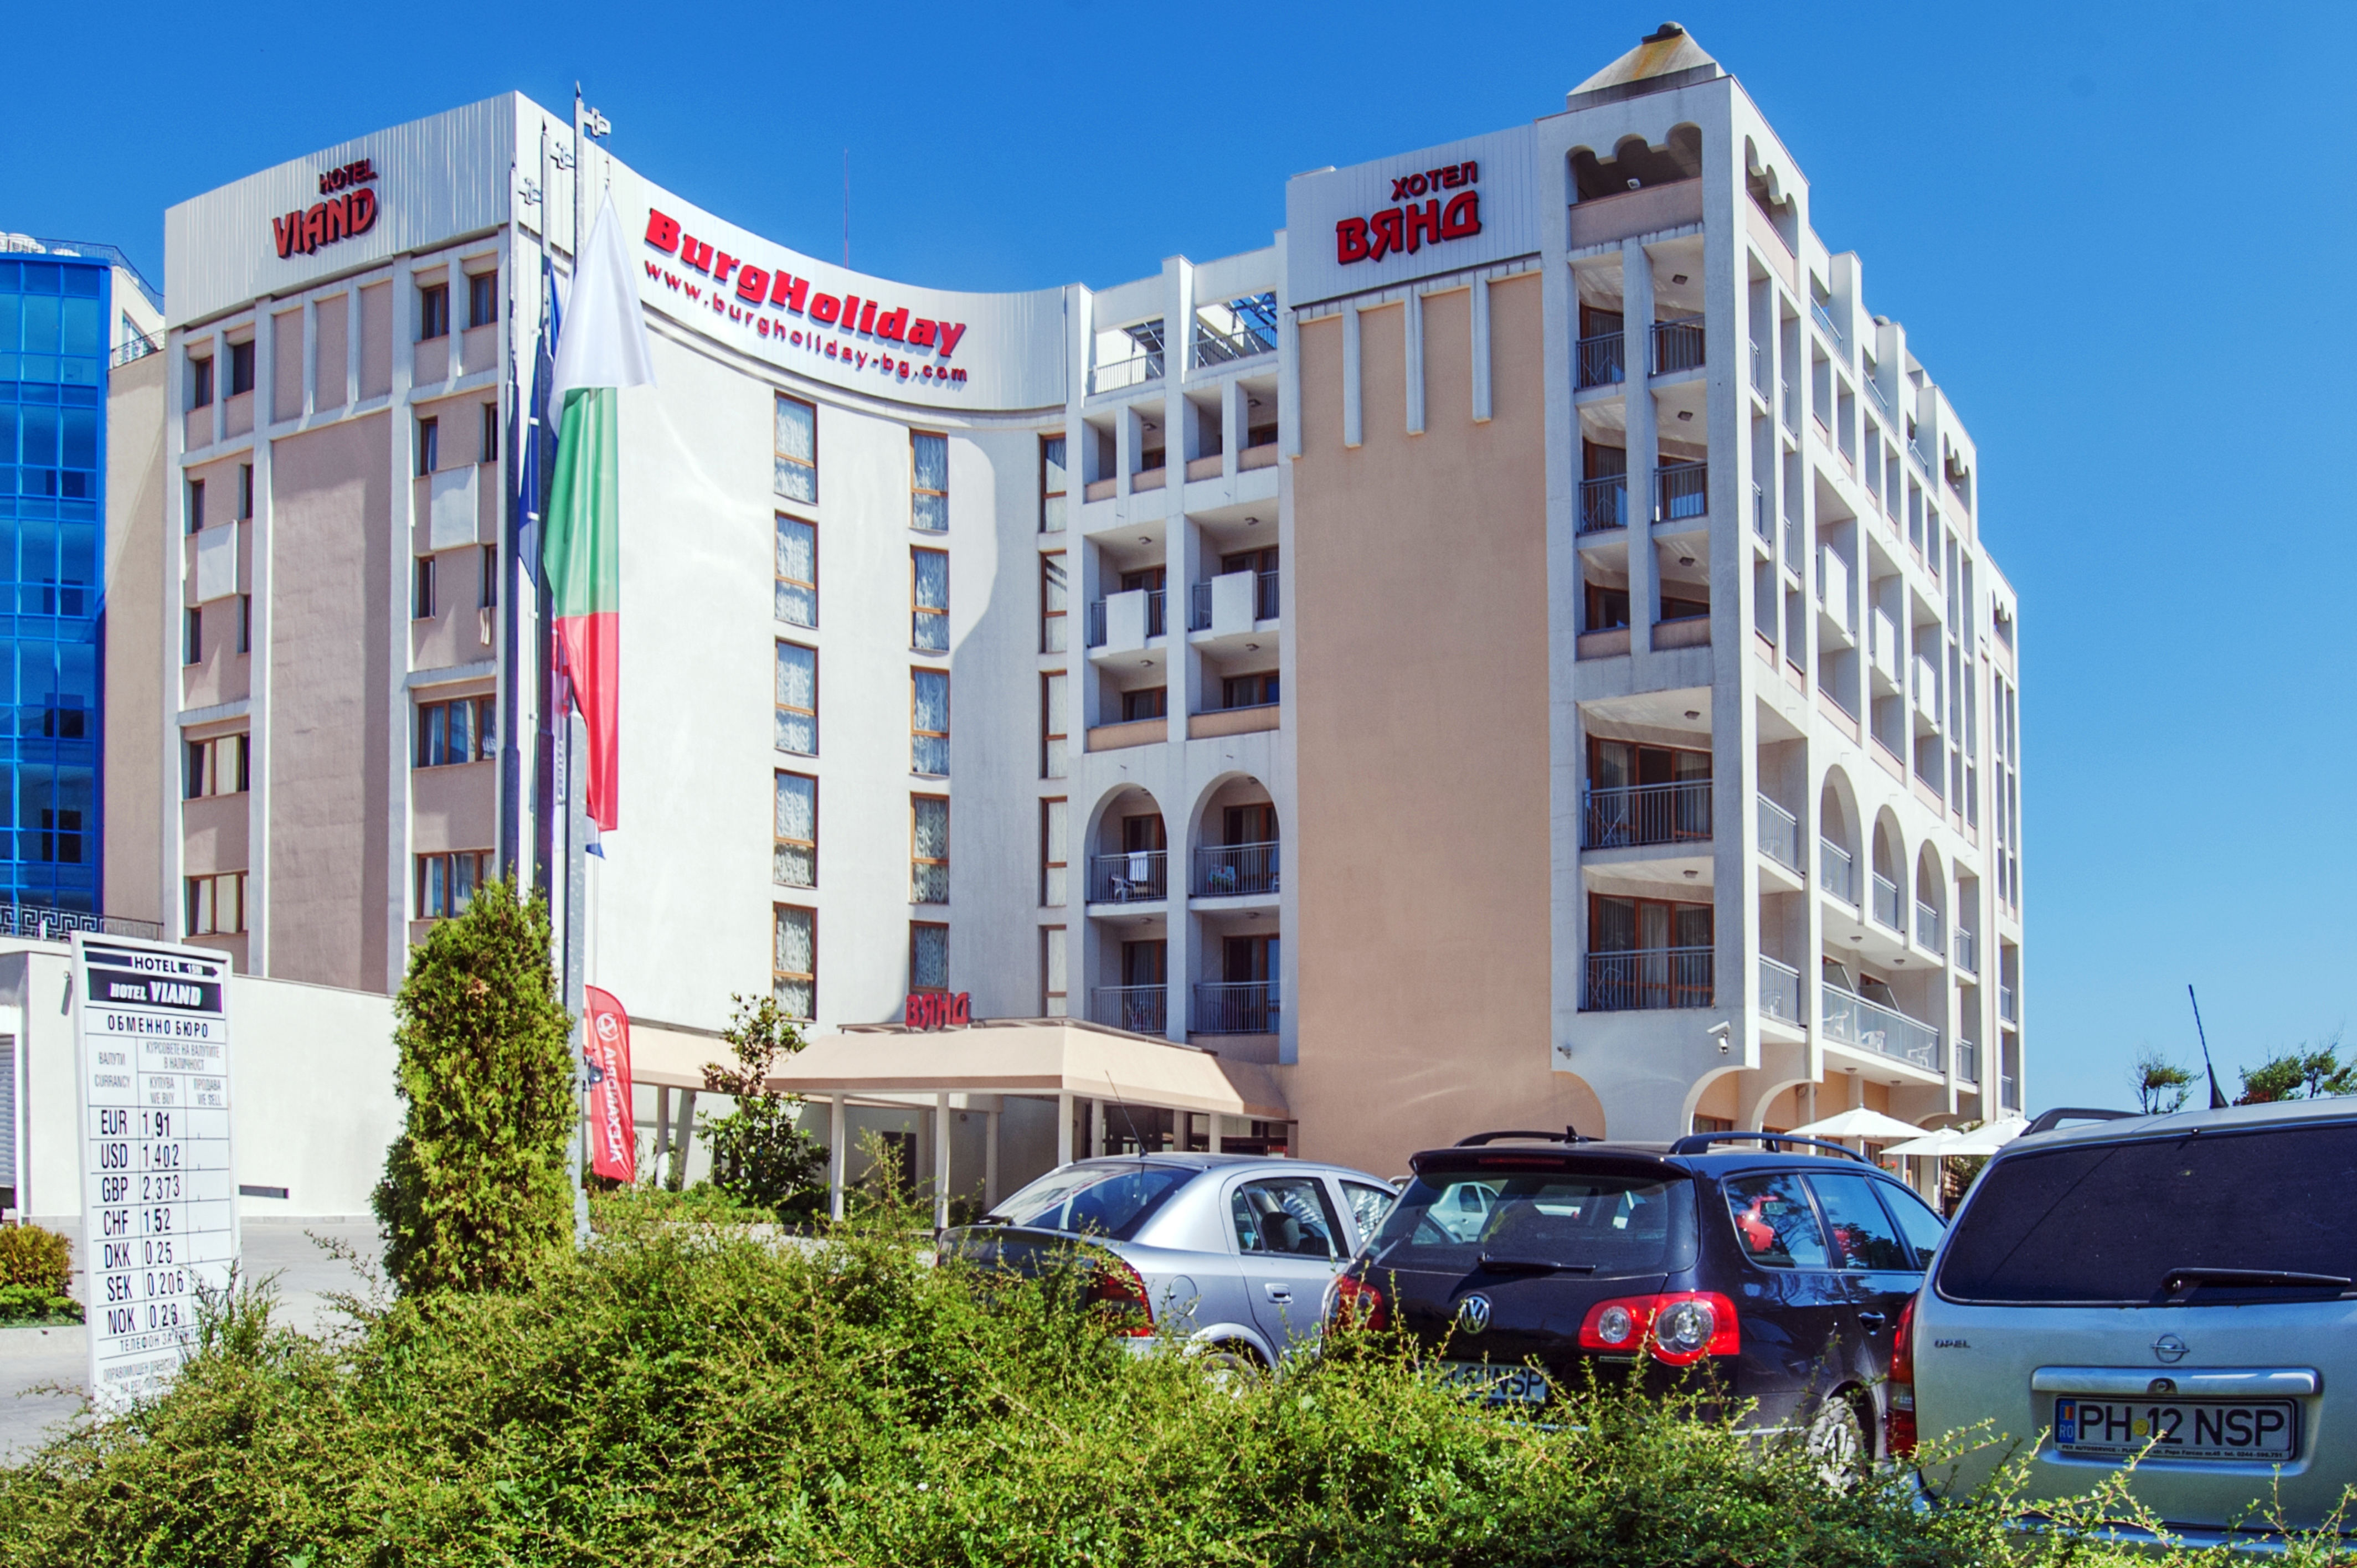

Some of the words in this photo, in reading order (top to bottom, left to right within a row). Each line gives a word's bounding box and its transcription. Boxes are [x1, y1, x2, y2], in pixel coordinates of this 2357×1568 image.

[319, 158, 378, 195] HOTEL
[1391, 161, 1478, 202] ХОТЕЛ
[272, 188, 378, 259] VIAND
[1336, 190, 1482, 265] ВЯНД
[645, 208, 966, 358] BurgHoliday
[645, 260, 967, 382] www.burgholiday-bg.com
[135, 956, 177, 973] HOTEL
[110, 983, 147, 1001] HOTEL
[150, 981, 202, 1007] VIAND
[905, 992, 971, 1031] ВЯНД
[108, 1015, 171, 1034] ОБМЕННО
[176, 1021, 208, 1038] БЮРО
[99, 1051, 126, 1065] ВАЛУТИ
[182, 1044, 189, 1056] НА
[150, 1092, 160, 1104] WE
[162, 1093, 174, 1105] BUY
[197, 1094, 207, 1105] WE
[208, 1094, 222, 1106] SELL
[101, 1110, 127, 1134] EUR
[101, 1143, 127, 1168] USD
[102, 1177, 128, 1202] GBP
[104, 1210, 128, 1236] CHF
[105, 1242, 131, 1268] DKK
[107, 1275, 132, 1301] SEK
[108, 1307, 135, 1335] NOK
[120, 1335, 159, 1352] ТЕЛЕФОН
[162, 1333, 172, 1345] ЗА
[1934, 1339, 1971, 1348] OPEL
[2059, 1425, 2074, 1438] RO
[2078, 1405, 2132, 1441] PH
[2147, 1407, 2183, 1445] 12
[2195, 1408, 2285, 1447] NSP
